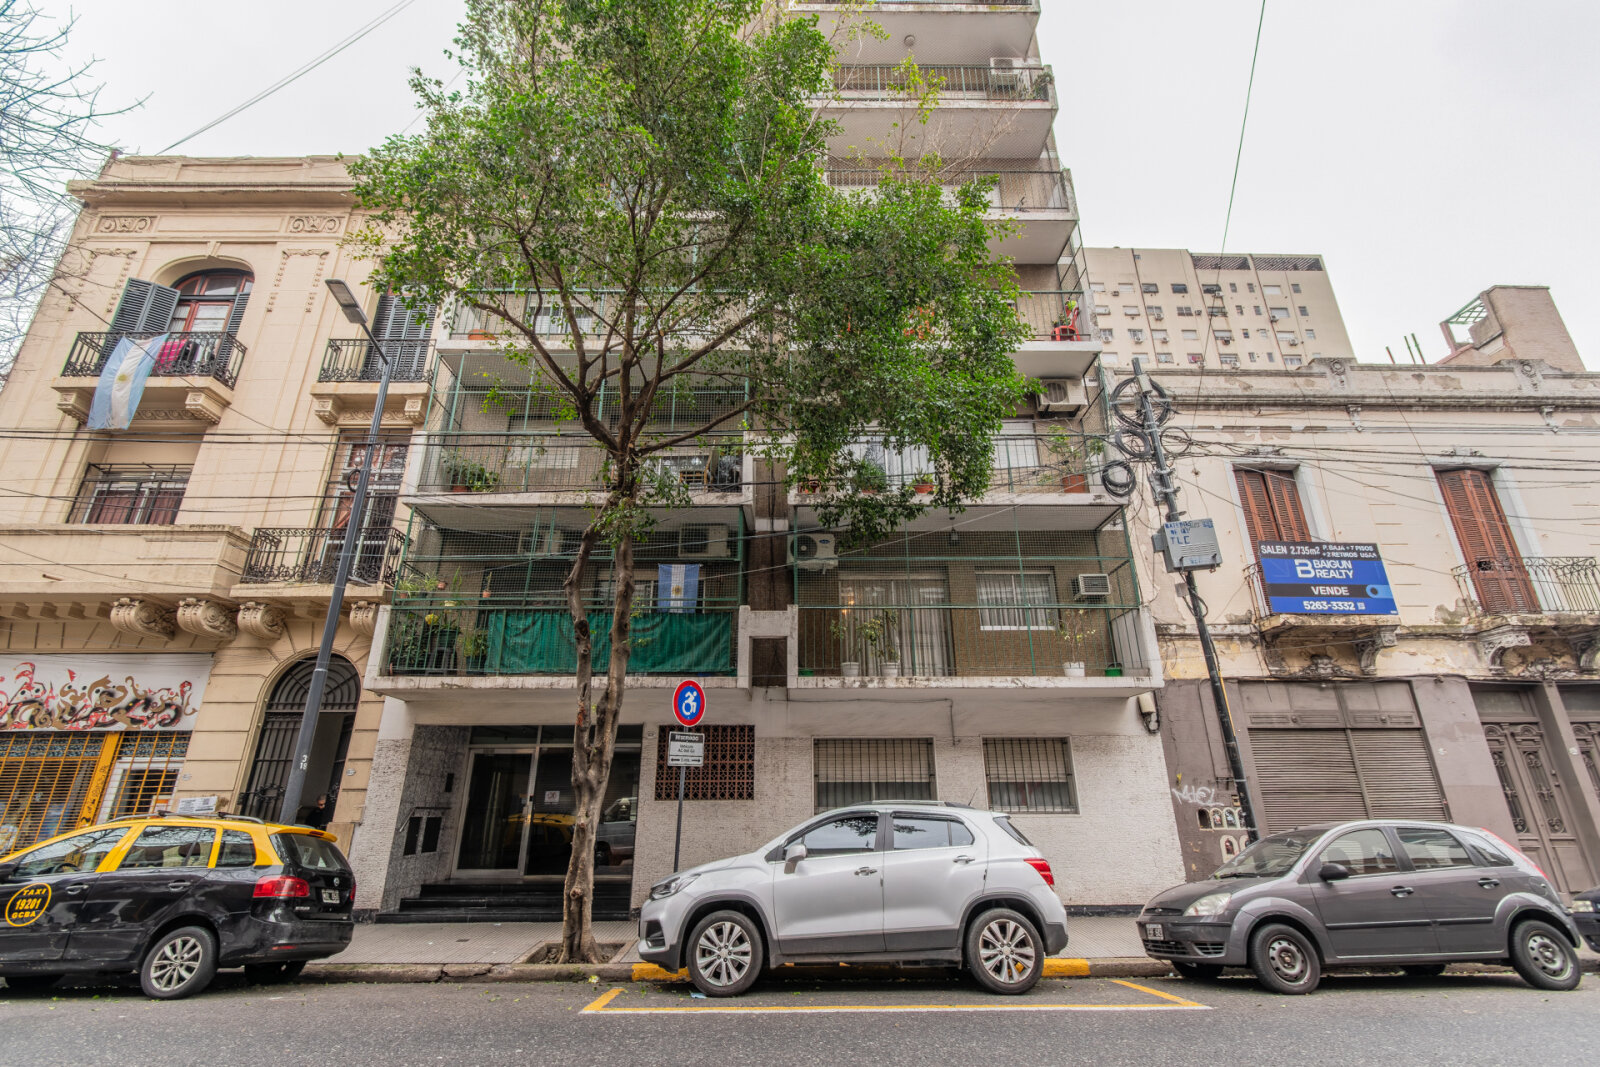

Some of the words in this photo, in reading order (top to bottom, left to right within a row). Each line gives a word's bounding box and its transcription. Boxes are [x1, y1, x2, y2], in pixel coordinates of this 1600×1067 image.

[1260, 545, 1288, 554] SALEN
[1312, 559, 1352, 569] BAIGUN
[1315, 569, 1354, 579] REALTY
[1310, 586, 1350, 596] VENDE
[1303, 601, 1356, 610] 5263-3332
[23, 888, 47, 896] TAXI
[15, 898, 42, 910] 19201
[11, 911, 36, 919] GCBA
